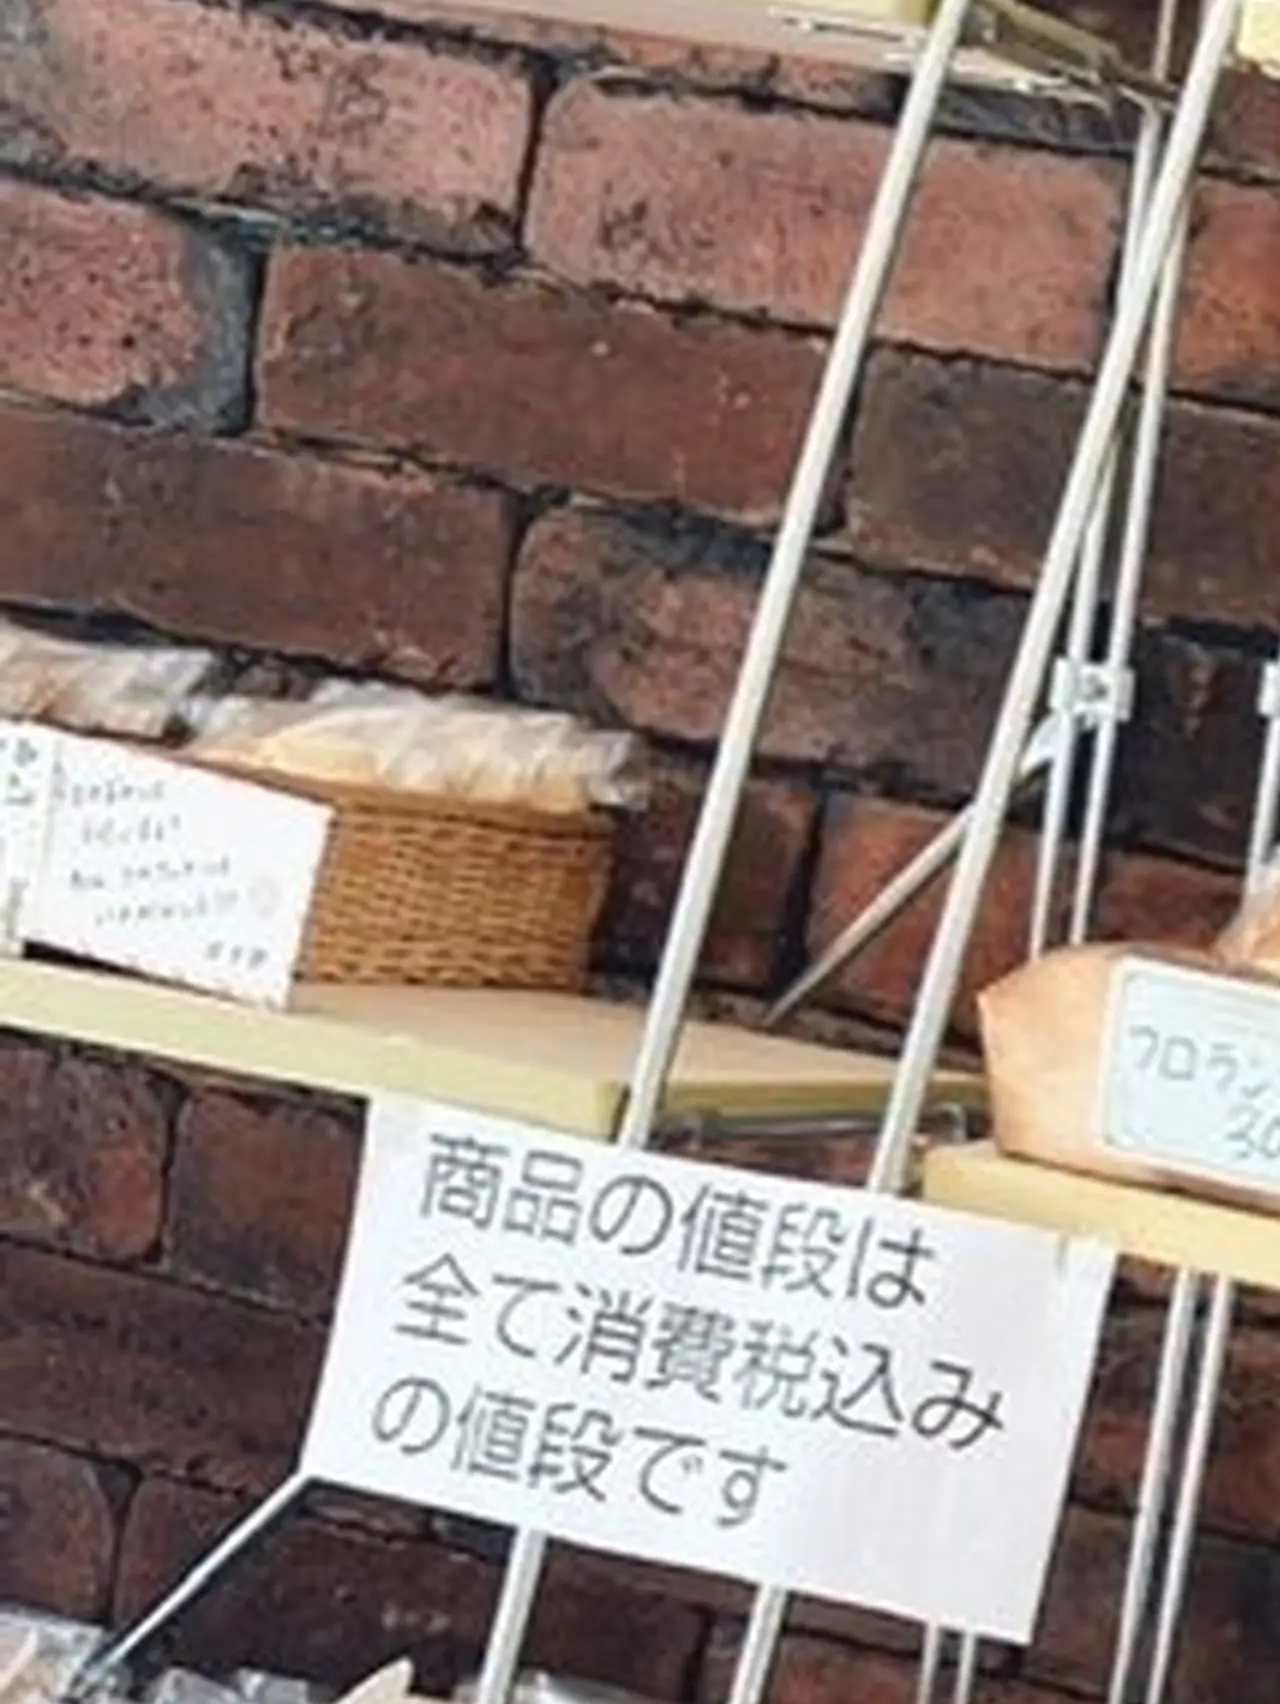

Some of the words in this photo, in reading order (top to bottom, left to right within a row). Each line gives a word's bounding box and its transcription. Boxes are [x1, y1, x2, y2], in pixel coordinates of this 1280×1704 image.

[417, 1130, 936, 1312] 商品の値段は
[392, 1249, 1008, 1454] 全て消費税込み
[369, 1374, 790, 1531] の値段です
